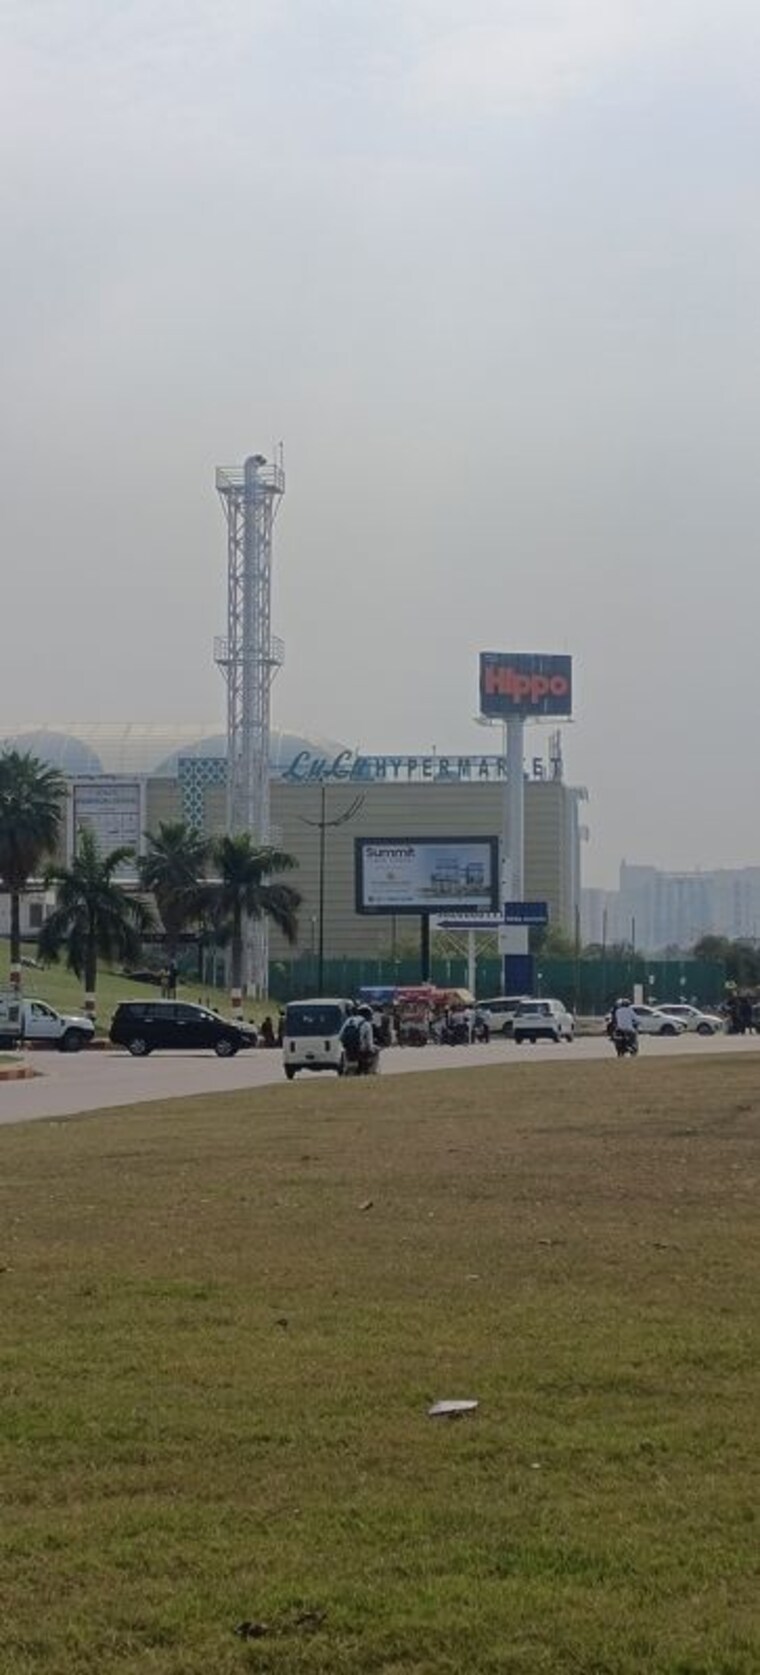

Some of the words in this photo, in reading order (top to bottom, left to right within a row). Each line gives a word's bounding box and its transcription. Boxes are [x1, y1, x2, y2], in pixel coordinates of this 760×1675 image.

[485, 663, 569, 704] Hippo
[375, 757, 562, 777] HYPERMARET
[365, 846, 415, 858] Summit
